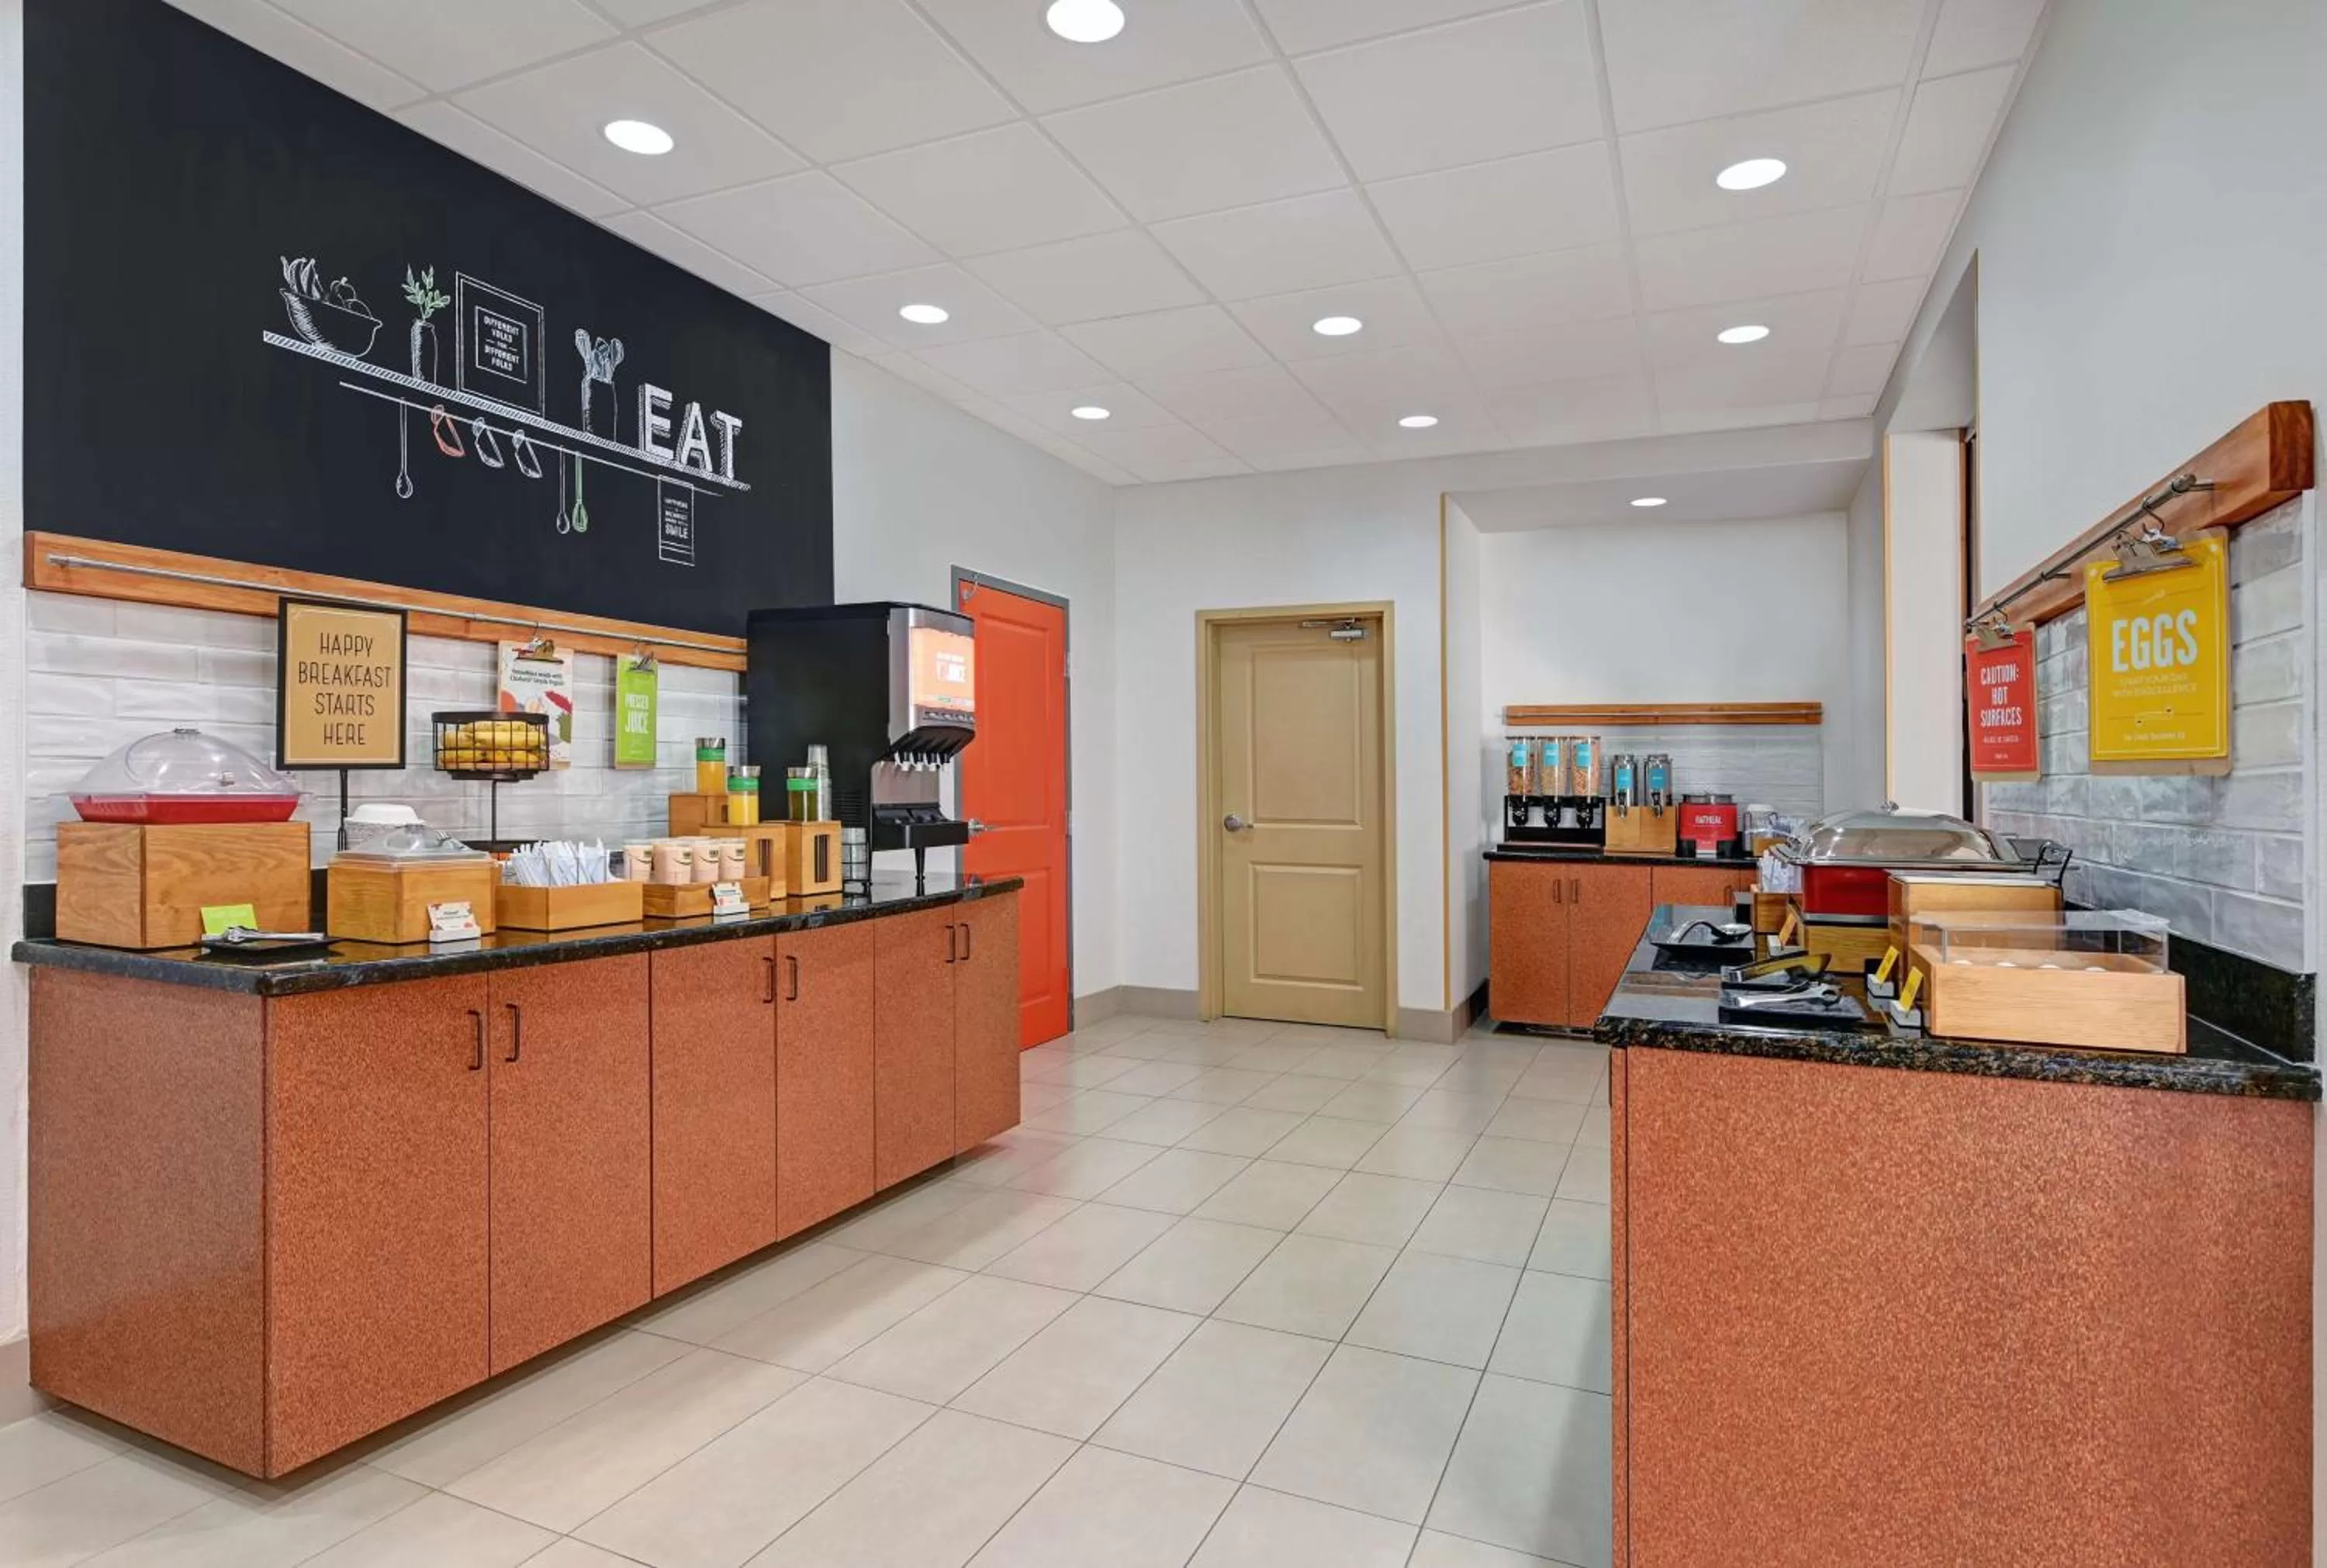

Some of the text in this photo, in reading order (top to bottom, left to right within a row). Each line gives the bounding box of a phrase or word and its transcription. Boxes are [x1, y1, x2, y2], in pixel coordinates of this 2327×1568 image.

[638, 382, 742, 479] EAT
[320, 632, 374, 658] HAPPY
[2112, 609, 2197, 673] EGGS
[298, 661, 392, 688] BREAKFAST
[1980, 664, 2019, 686] CAUTION:
[315, 692, 375, 716] STARTS
[1991, 686, 2008, 705] HOT
[624, 710, 650, 734] JUICE
[1980, 706, 2023, 727] SURFACES
[323, 723, 367, 745] HERE
[1695, 815, 1723, 824] OATMEAL
